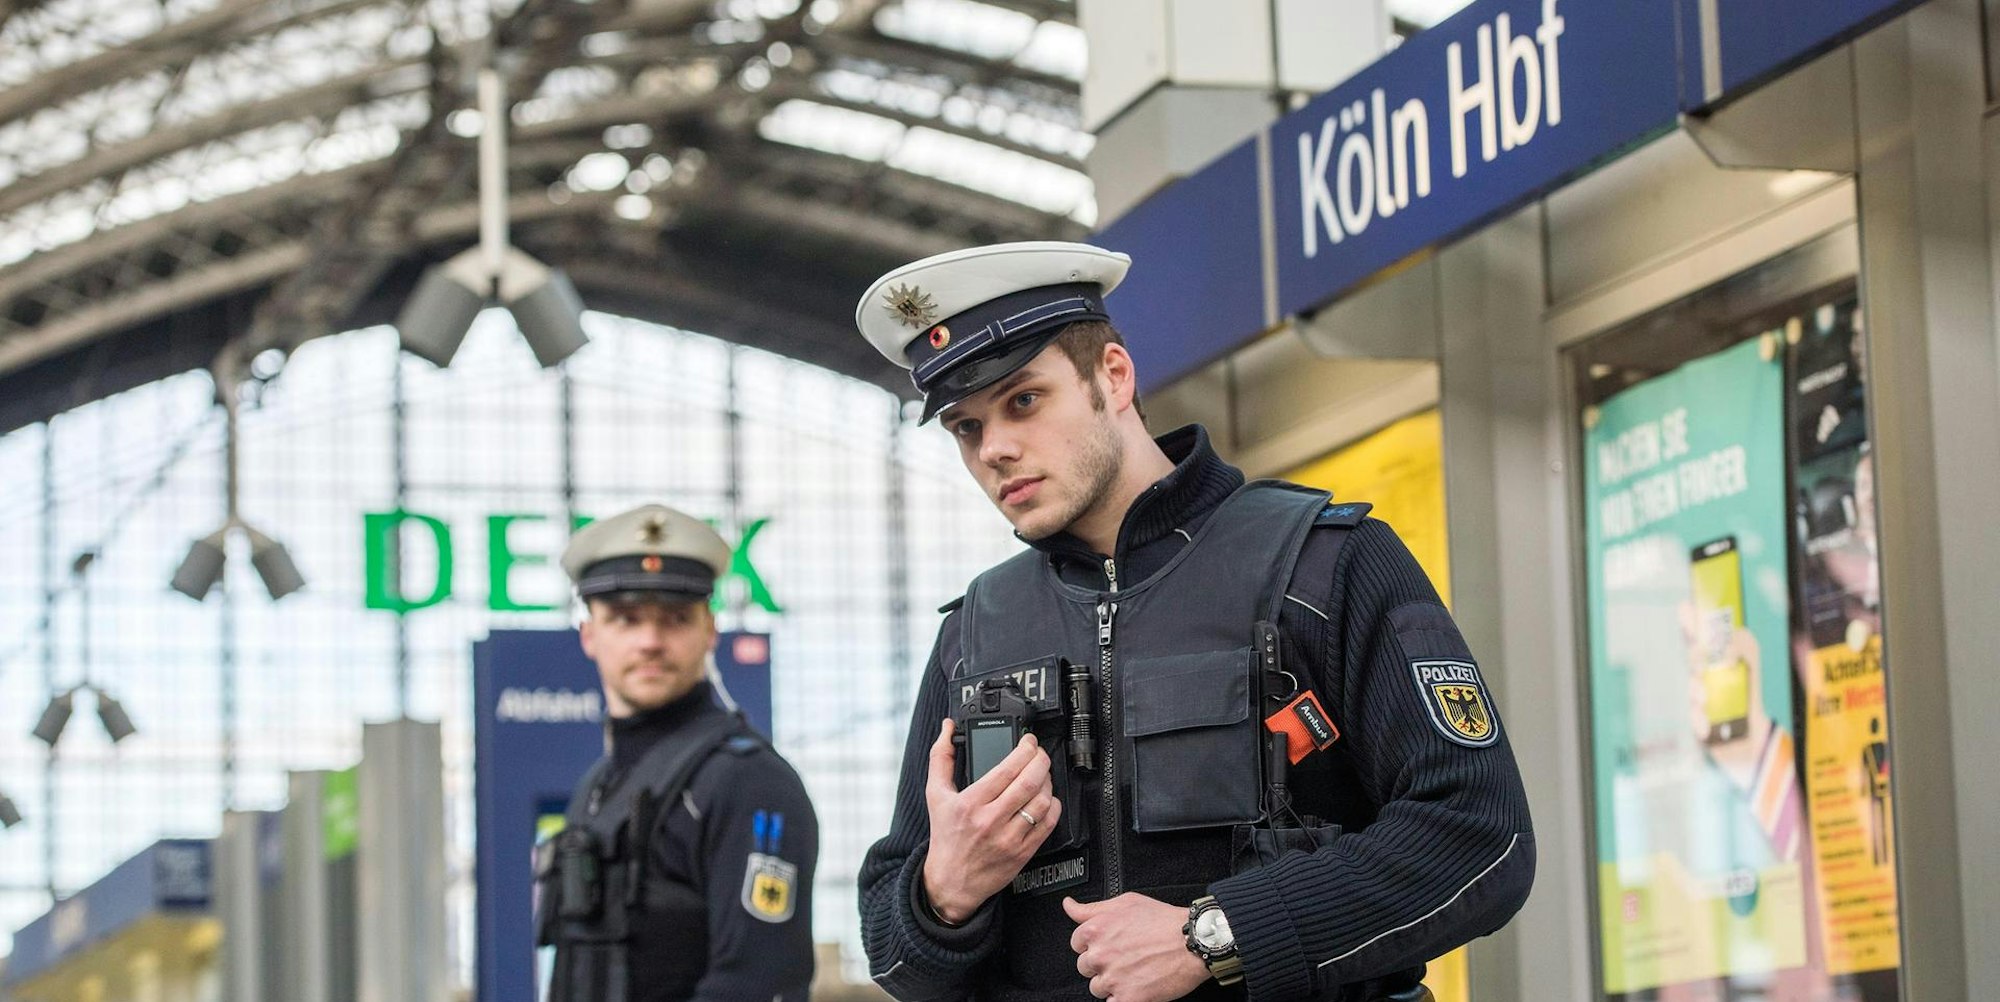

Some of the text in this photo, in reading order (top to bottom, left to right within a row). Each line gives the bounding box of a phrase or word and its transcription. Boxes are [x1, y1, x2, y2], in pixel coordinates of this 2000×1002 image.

[1298, 0, 1565, 259] Köln Hbf
[364, 508, 783, 614] DEK
[1420, 665, 1477, 684] POLIZEI
[977, 719, 1006, 727] MOTOROLA
